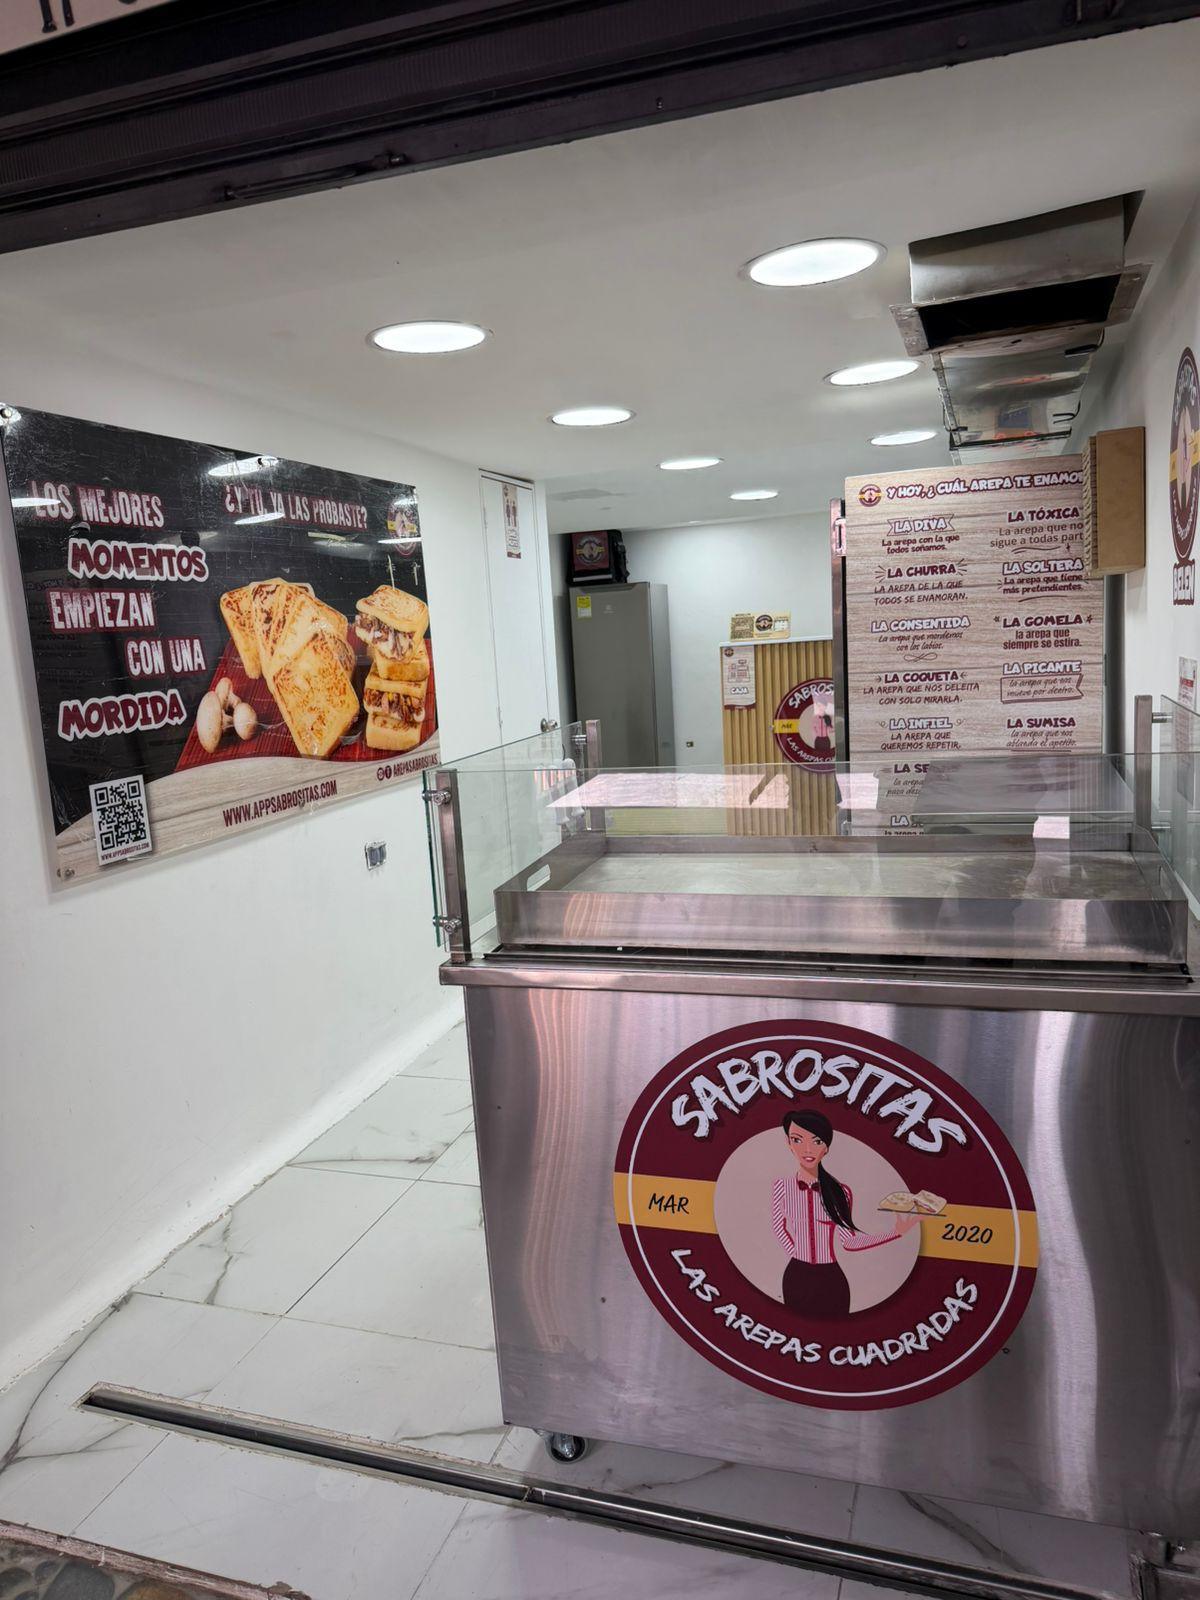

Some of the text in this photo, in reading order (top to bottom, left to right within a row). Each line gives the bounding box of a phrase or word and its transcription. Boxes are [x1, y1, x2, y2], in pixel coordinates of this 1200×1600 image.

[887, 486, 897, 500] Y
[898, 484, 925, 498] HOY,
[936, 478, 968, 494] CUÁL
[970, 476, 1012, 492] AREPA
[1014, 474, 1032, 489] TE
[31, 481, 165, 528] LOS MEJORES
[225, 485, 243, 514] ¿Y
[270, 491, 286, 518] YA
[288, 494, 310, 522] LAS
[313, 500, 368, 529] PROBASTE?
[1008, 507, 1080, 522] LA TÓXICA
[894, 517, 947, 534] LA DIVA
[1014, 525, 1044, 537] arepa
[1046, 524, 1067, 534] que
[882, 538, 892, 546] La
[894, 538, 917, 546] arepa
[918, 536, 934, 544] con
[945, 534, 960, 544] que
[990, 538, 1018, 548] sigue
[1029, 534, 1059, 544] todas
[887, 546, 910, 554] todos
[68, 537, 209, 582] MOMENTOS
[887, 564, 956, 578] LA CHURRA
[1002, 558, 1084, 576] LA SOLTERA
[1016, 576, 1041, 584] arepa
[1043, 576, 1058, 584] que
[1060, 574, 1083, 582] tiene
[874, 580, 963, 594] LA AREPA DE LA QUE
[1003, 586, 1020, 594] más
[874, 592, 968, 606] TODOS SE ENAMORAN.
[50, 591, 155, 630] EMPIEZAN
[871, 615, 971, 634] LA CONSENTIDA
[1002, 614, 1083, 628] LA GOMELA
[890, 634, 911, 644] arepa
[912, 634, 925, 642] que
[1016, 628, 1070, 640] la arepa que
[896, 644, 908, 652] con
[910, 641, 920, 650] los
[1003, 638, 1082, 650] siempre se estira.
[127, 638, 206, 676] CON UNA
[1002, 660, 1082, 676] LA PICANTE
[884, 671, 959, 684] LA COQUETA
[1020, 679, 1042, 688] arepa
[1044, 678, 1058, 688] que
[863, 682, 980, 694] LA AREPA QUE NOS DELEITA
[1032, 688, 1046, 698] por
[789, 683, 834, 708] SABROS
[879, 695, 963, 706] CON SOLO MIRARLA.
[58, 688, 188, 742] MORDIDA
[889, 716, 953, 730] LA INFIEL
[1007, 717, 1076, 729] LA SUMISA
[891, 732, 952, 740] LA AREPA QUE
[1021, 730, 1044, 740] arepa
[1046, 730, 1060, 741] que
[787, 737, 800, 752] LAS
[881, 741, 962, 750] QUEREMOS REPETIR.
[894, 764, 911, 774] LA
[222, 780, 338, 827] WWW.APPSABROSITAS.COM
[890, 815, 910, 828] LA
[671, 1050, 968, 1154] SABROSITAS
[648, 1193, 690, 1214] MAR
[941, 1224, 994, 1244] 2020
[671, 1249, 978, 1367] LAS AREPAS CUADRADAS
